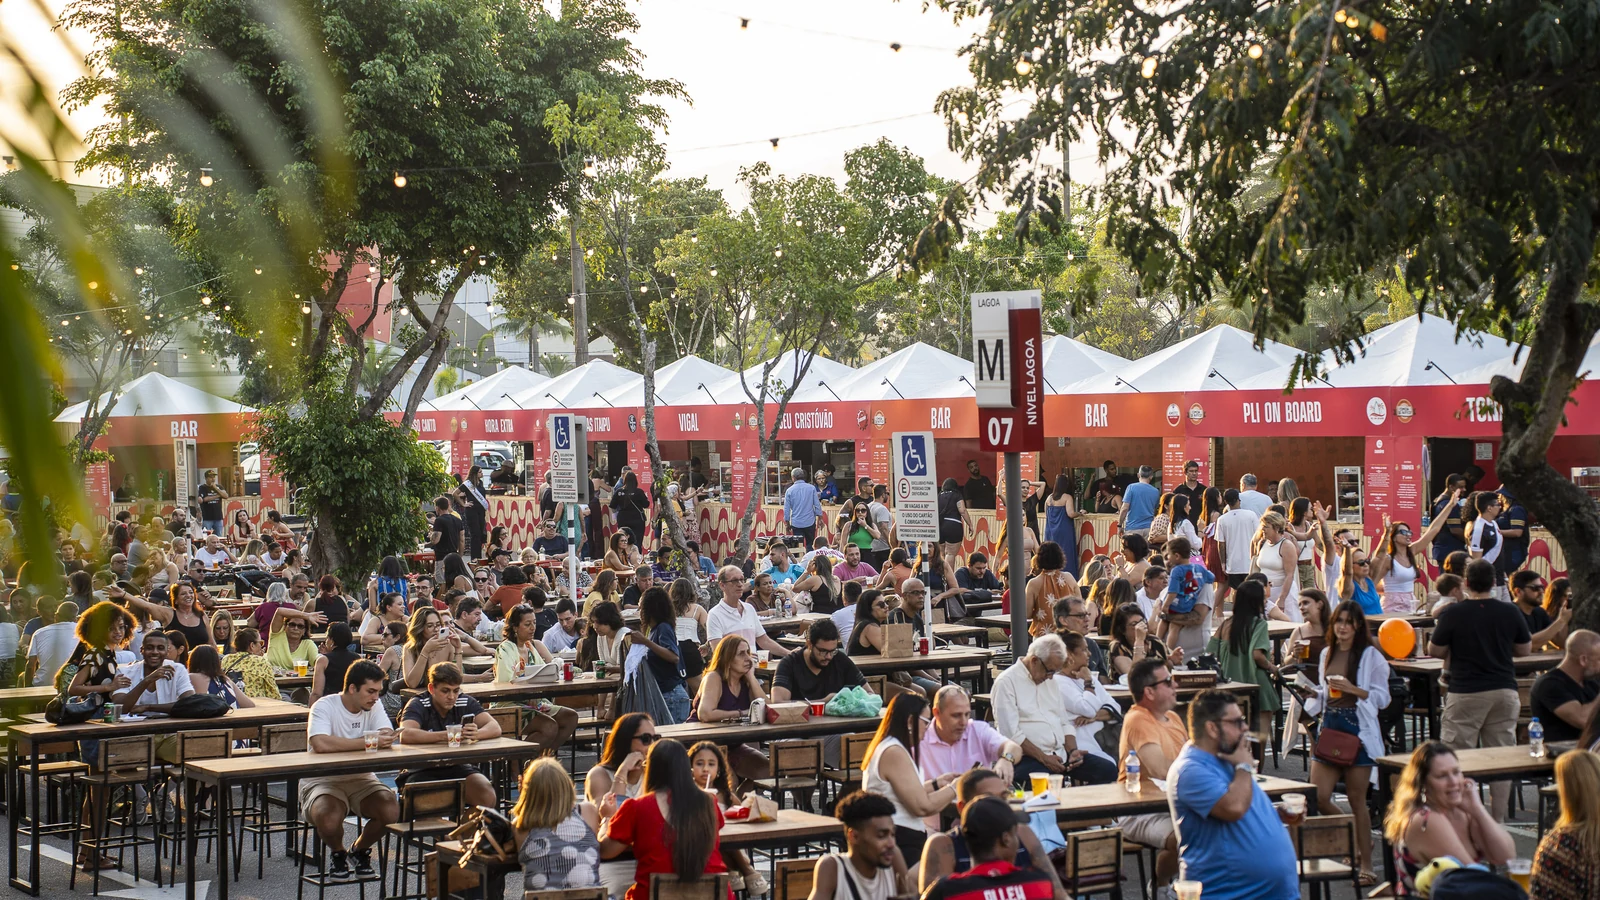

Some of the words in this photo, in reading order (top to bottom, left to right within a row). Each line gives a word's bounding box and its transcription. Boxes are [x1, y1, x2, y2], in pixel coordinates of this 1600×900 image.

[978, 298, 1001, 308] LAGOA
[978, 339, 1005, 381] M
[1025, 338, 1036, 384] LAGOA
[1026, 387, 1038, 426] NÍVEL
[1084, 403, 1108, 428] BAR
[1242, 402, 1260, 424] PLI
[1264, 402, 1281, 424] ON
[1284, 401, 1322, 423] BOARD
[421, 418, 436, 432] CANTO
[484, 418, 499, 433] HORA
[500, 418, 514, 432] EXTRA
[594, 417, 610, 432] ITAIPU
[678, 412, 699, 432] VIGAL
[794, 408, 833, 429] CRISTÓVÃO
[930, 407, 950, 428] BAR
[170, 420, 198, 438] BAR
[988, 417, 1014, 446] 07
[902, 483, 907, 494] E
